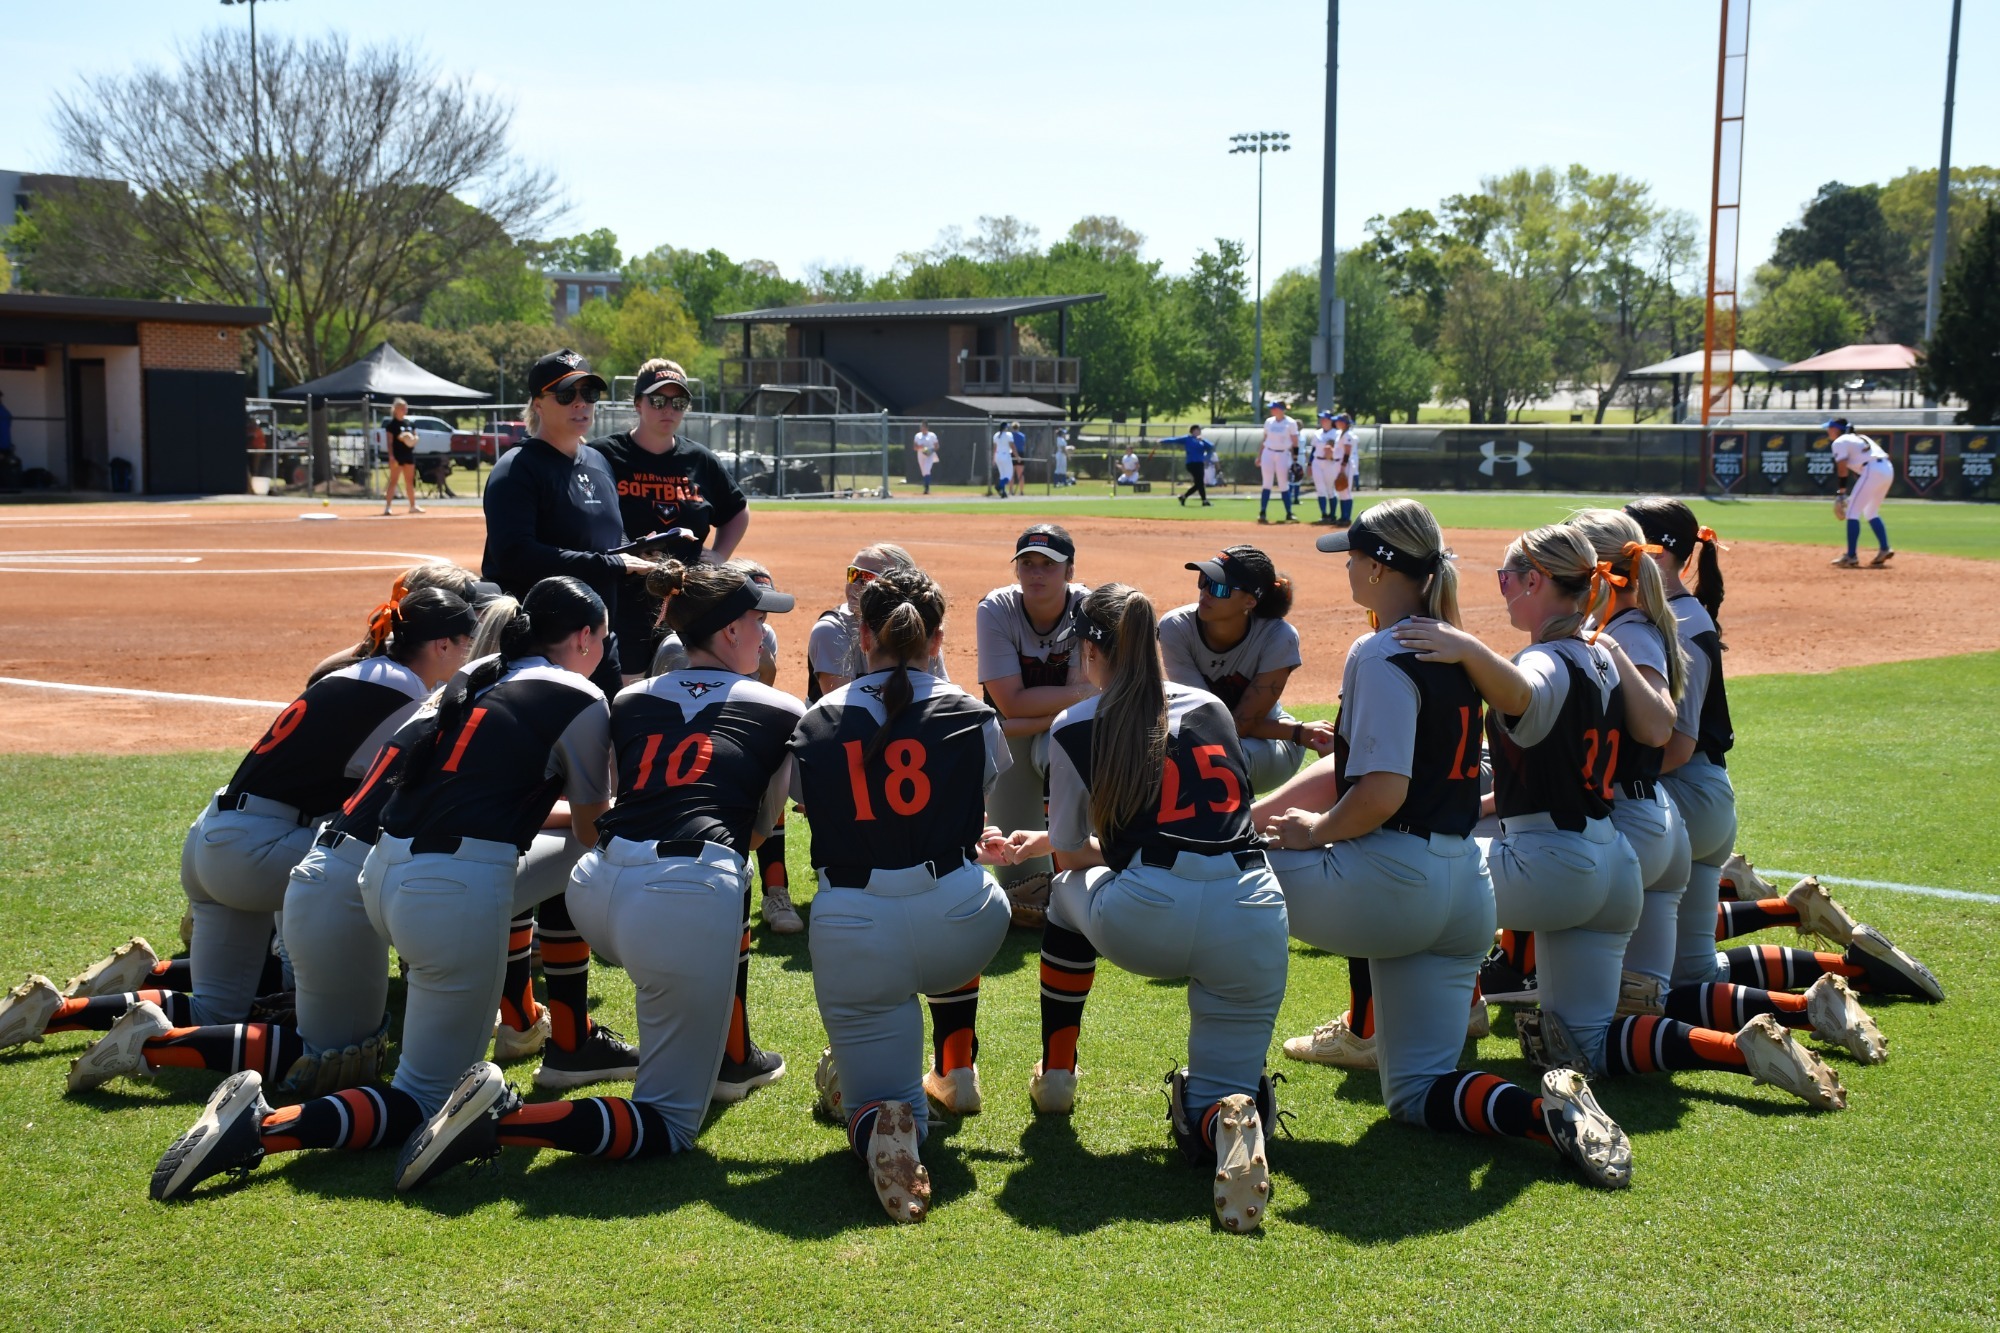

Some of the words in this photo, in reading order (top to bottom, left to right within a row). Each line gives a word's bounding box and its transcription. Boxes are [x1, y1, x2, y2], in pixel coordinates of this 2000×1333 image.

[1715, 464, 1740, 474] 2021
[1761, 462, 1788, 473] 2021
[1807, 463, 1834, 474] 2022
[1908, 465, 1938, 477] 2024
[1962, 464, 1992, 475] 2025
[633, 472, 689, 484] WARHAWKS
[617, 480, 704, 502] SOFTBALL
[633, 732, 713, 790] 10
[842, 738, 931, 821] 18
[1156, 744, 1241, 825] 25
